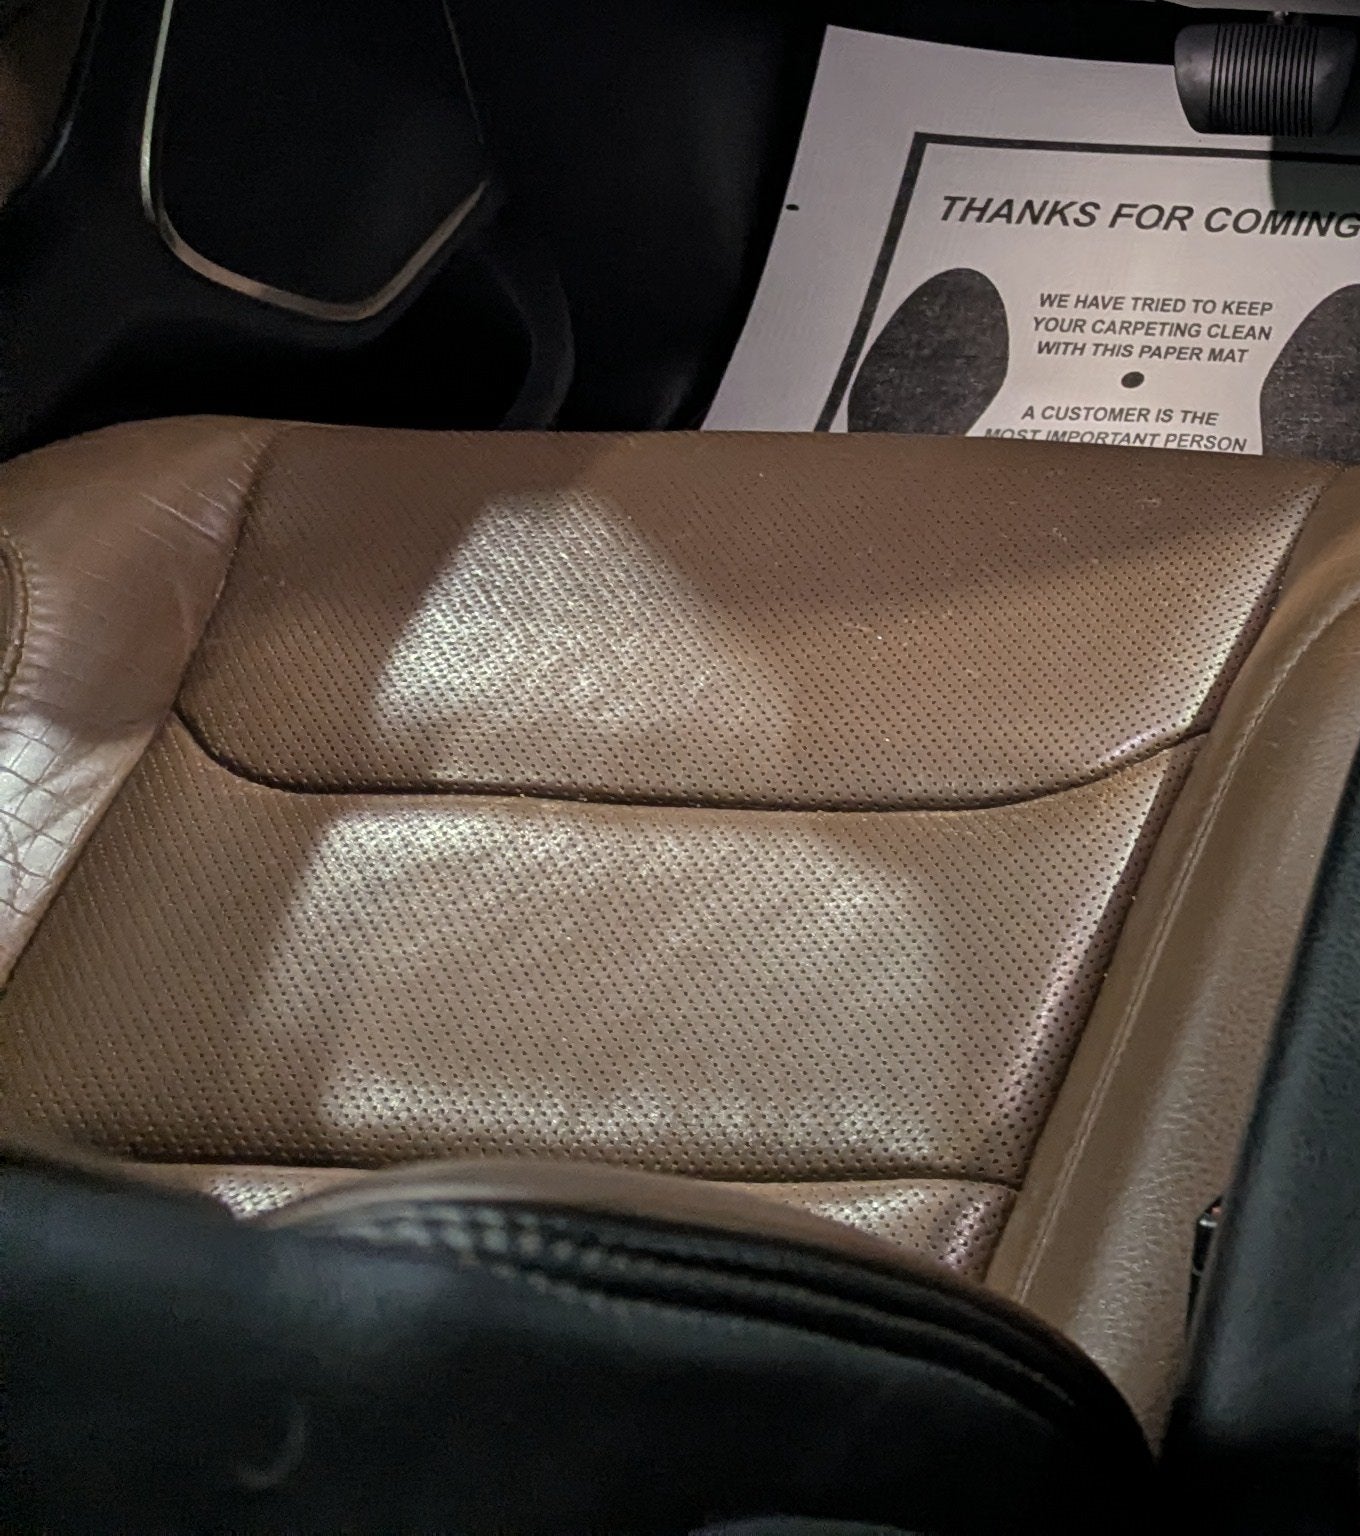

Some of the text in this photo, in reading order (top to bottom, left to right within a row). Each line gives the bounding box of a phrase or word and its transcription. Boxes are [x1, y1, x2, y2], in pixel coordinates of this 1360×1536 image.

[939, 195, 1101, 229] THANKS
[1108, 203, 1195, 231] FOR
[1039, 293, 1273, 316] WE HAVE TRIED TO KEEP
[1032, 316, 1272, 341] YOUR CARPETING CLEAN
[1036, 340, 1248, 364] WITH THIS PAPER MAT
[1021, 405, 1219, 426] A CUSTOMER IS THE
[1045, 430, 1160, 446] IMPORTANT
[1164, 432, 1247, 452] PERSON
